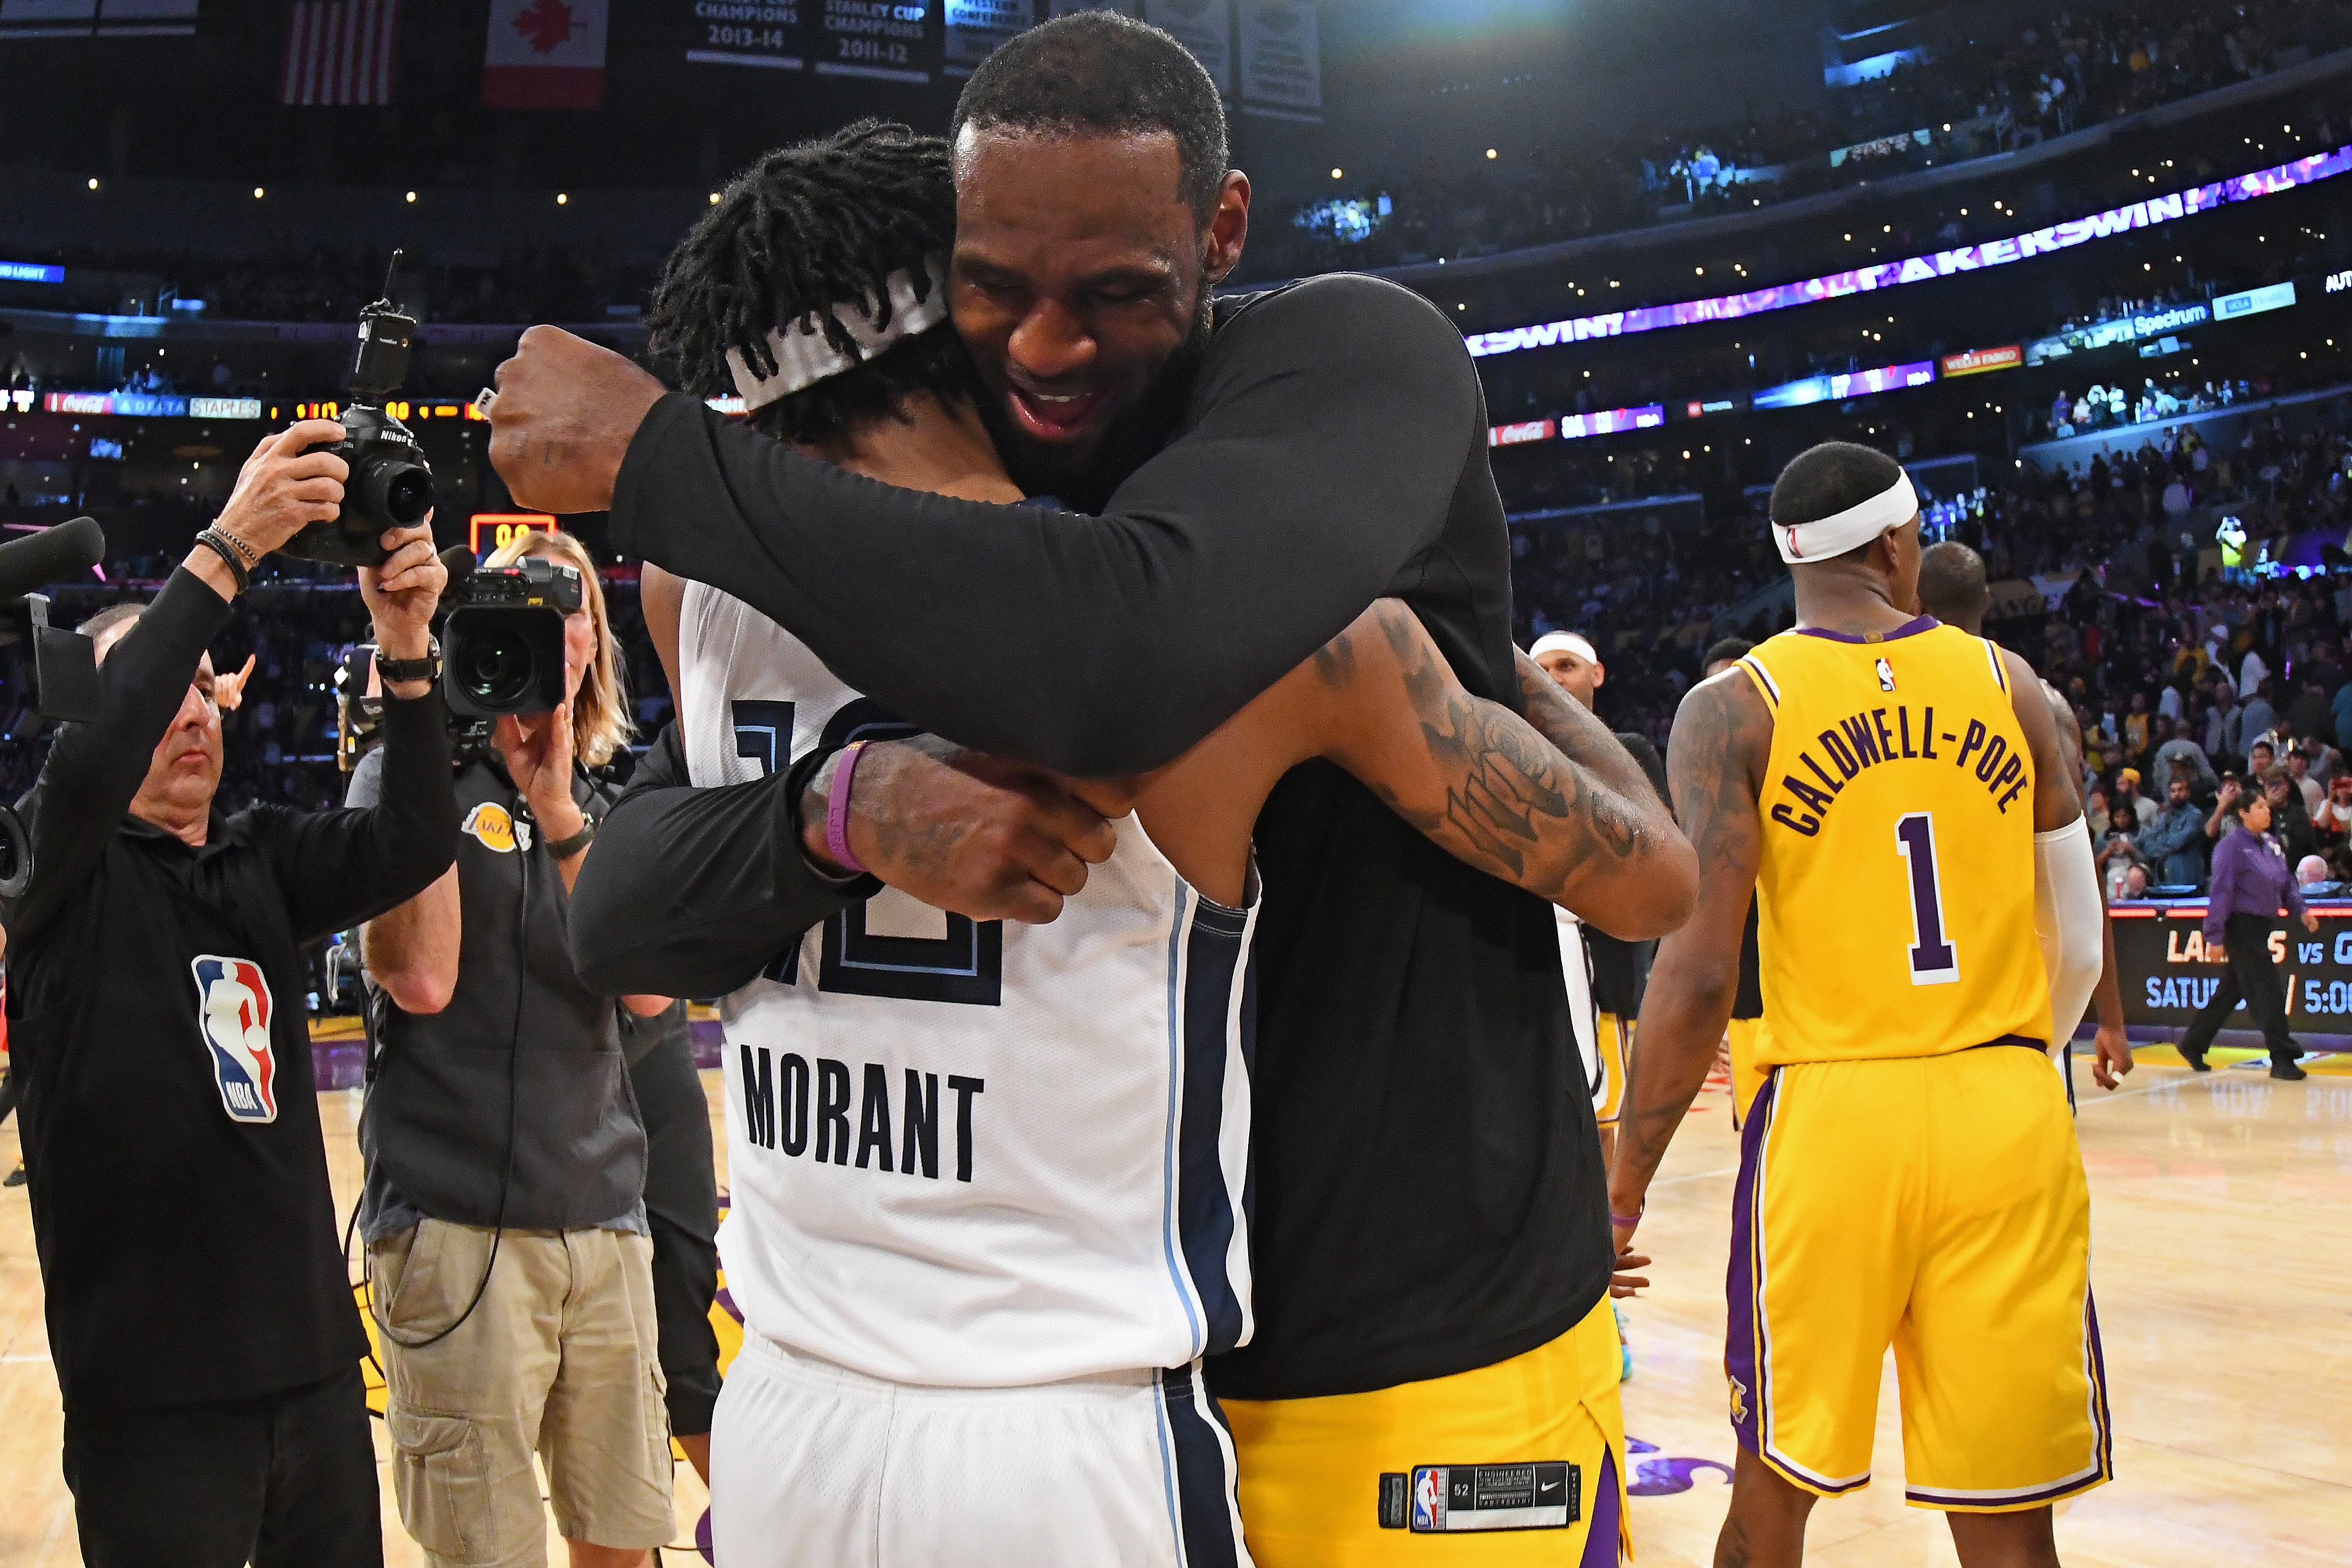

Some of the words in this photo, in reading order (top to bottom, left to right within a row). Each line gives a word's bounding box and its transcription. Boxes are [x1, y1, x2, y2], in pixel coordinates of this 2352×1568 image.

[695, 2, 797, 24] CHAMPIONS
[708, 24, 784, 49] 2013-14
[839, 38, 908, 63] 2011-12
[380, 430, 407, 443] Nikon
[1771, 705, 2029, 837] CALDWELL-POPE
[1894, 811, 1959, 986] 1
[2166, 930, 2288, 964] LAS
[2304, 979, 2352, 1014] 5:0
[225, 1081, 258, 1110] NBA
[740, 1044, 985, 1183] MORANT
[1454, 1483, 1469, 1497] 52
